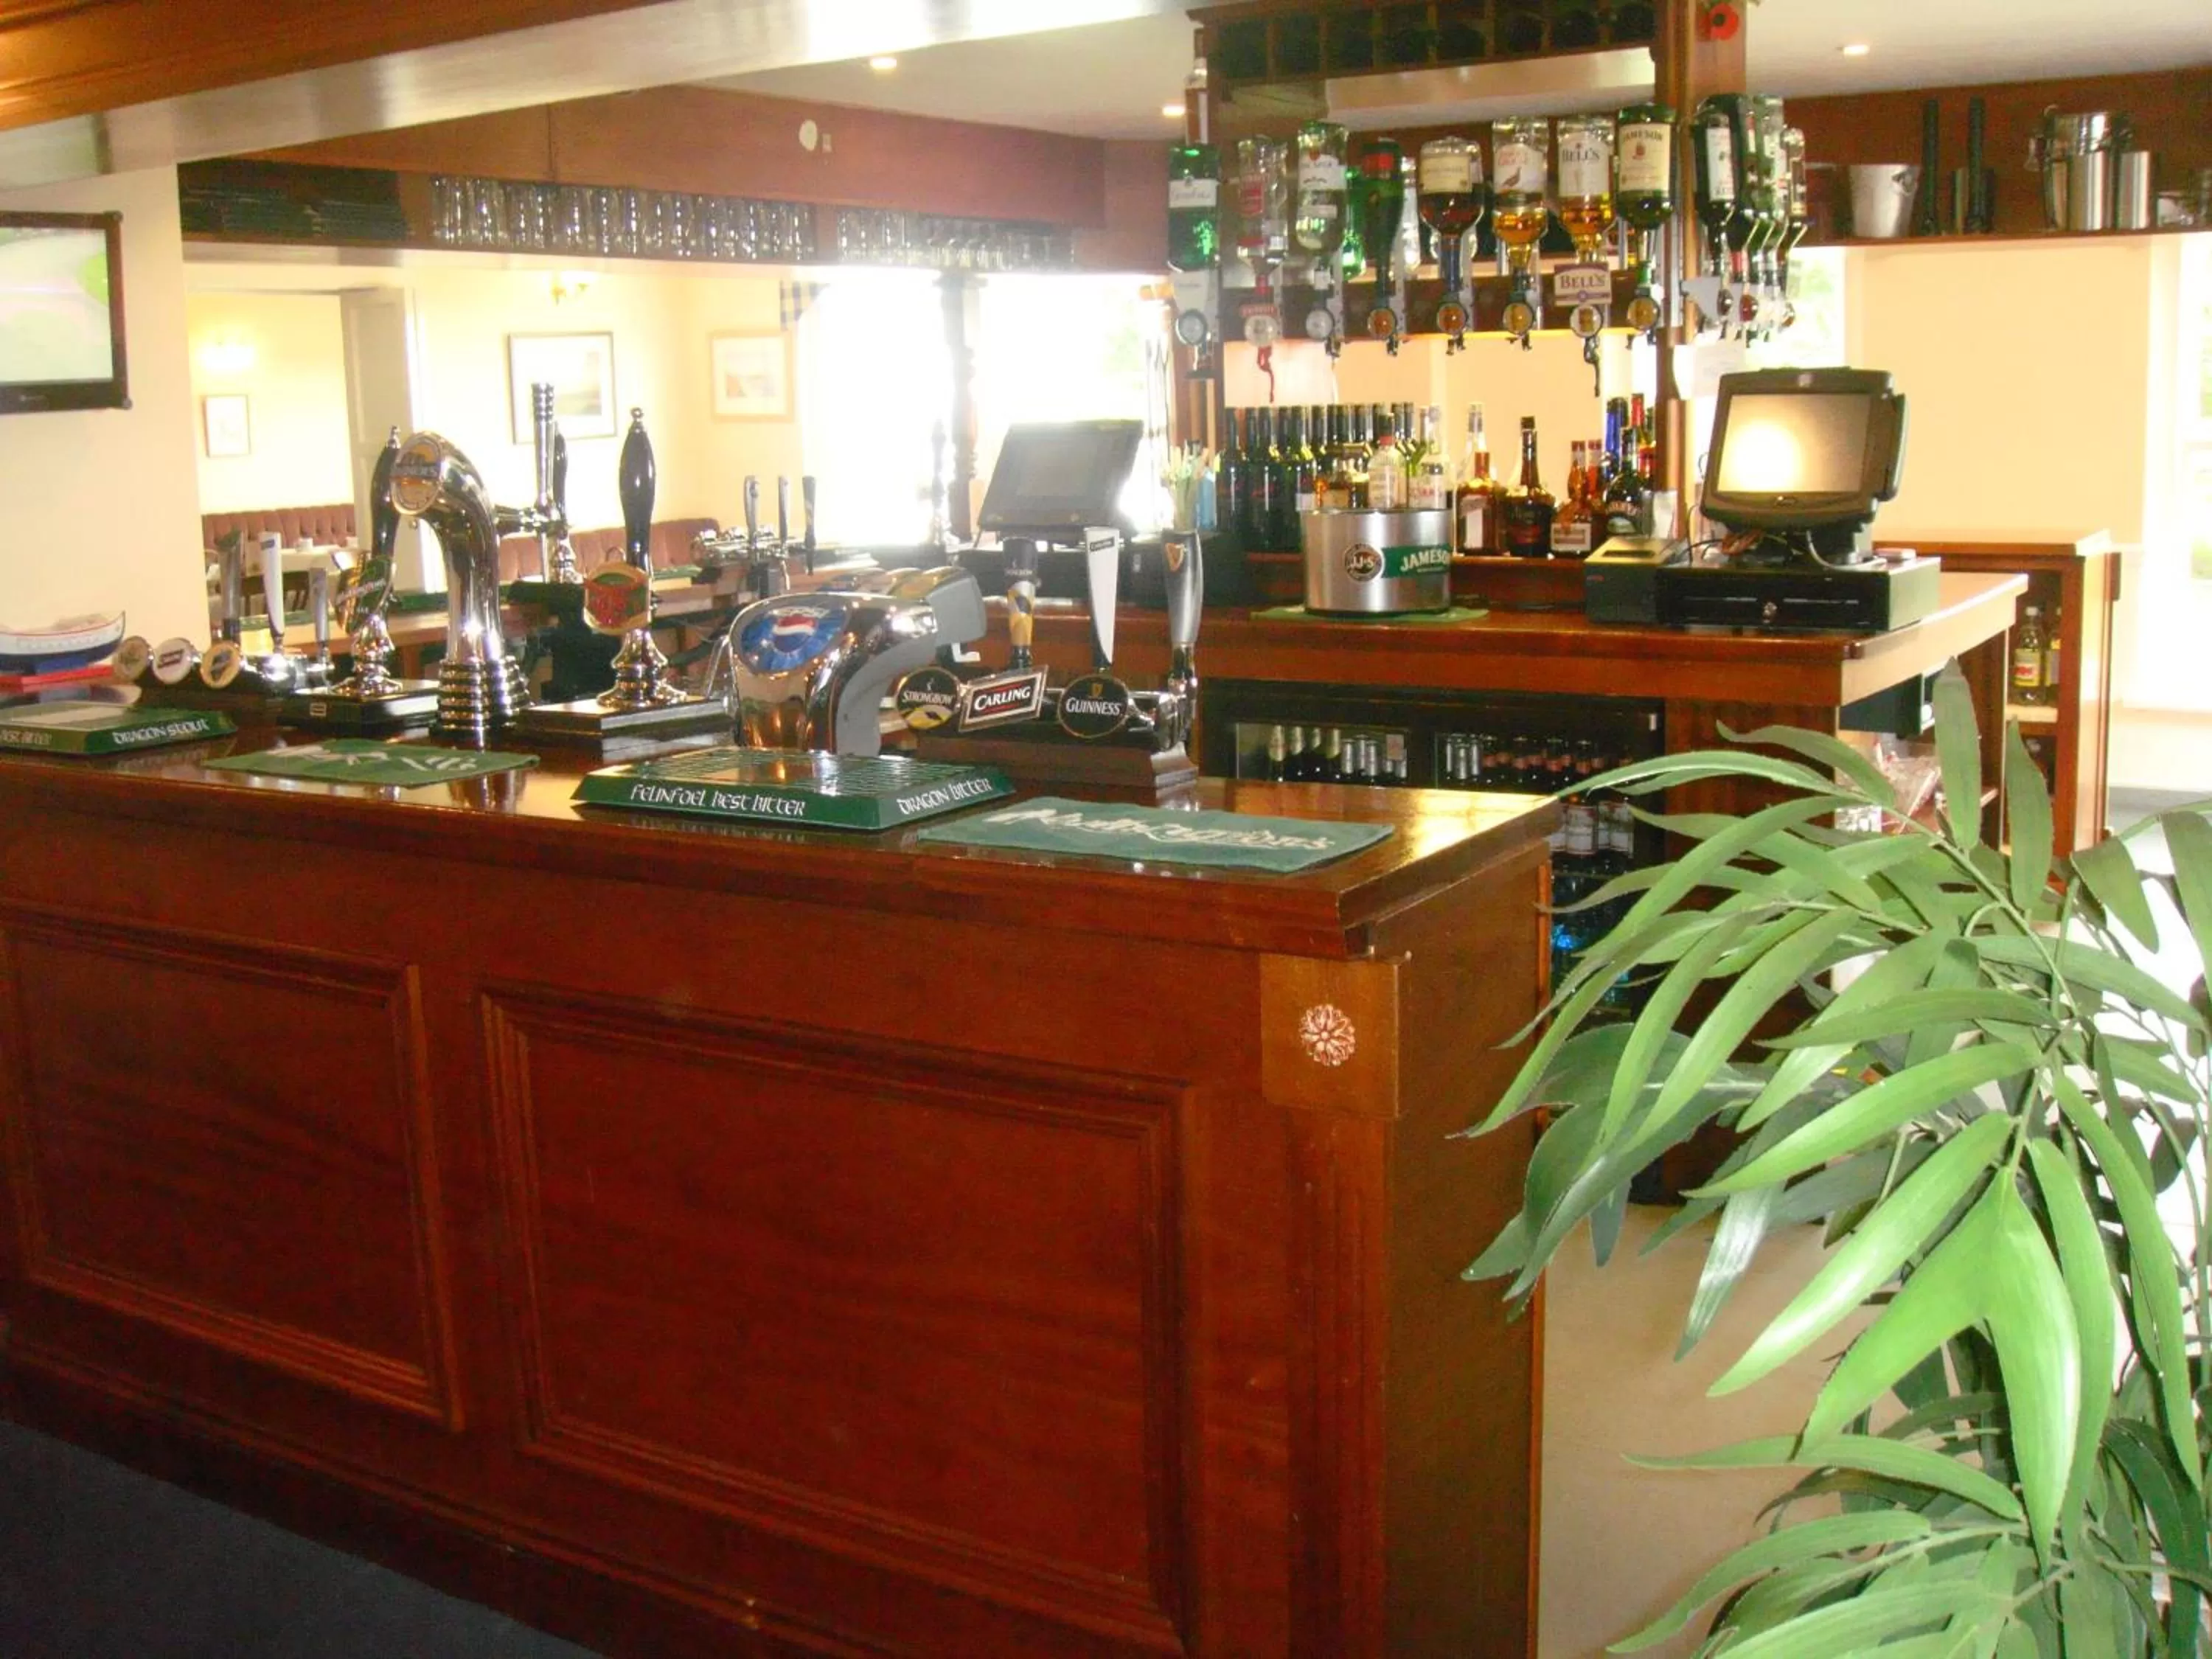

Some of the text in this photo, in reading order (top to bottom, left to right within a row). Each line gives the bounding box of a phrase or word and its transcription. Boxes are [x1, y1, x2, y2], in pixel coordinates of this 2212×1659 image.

[902, 689, 956, 705] STRONGBOW
[974, 686, 1032, 711] CARLING
[1065, 697, 1122, 716] GUINNESS
[112, 726, 167, 745] DRAGON
[630, 784, 806, 816] FELINFOEL BEST BITTER
[896, 778, 992, 815] DRAGON BITTER
